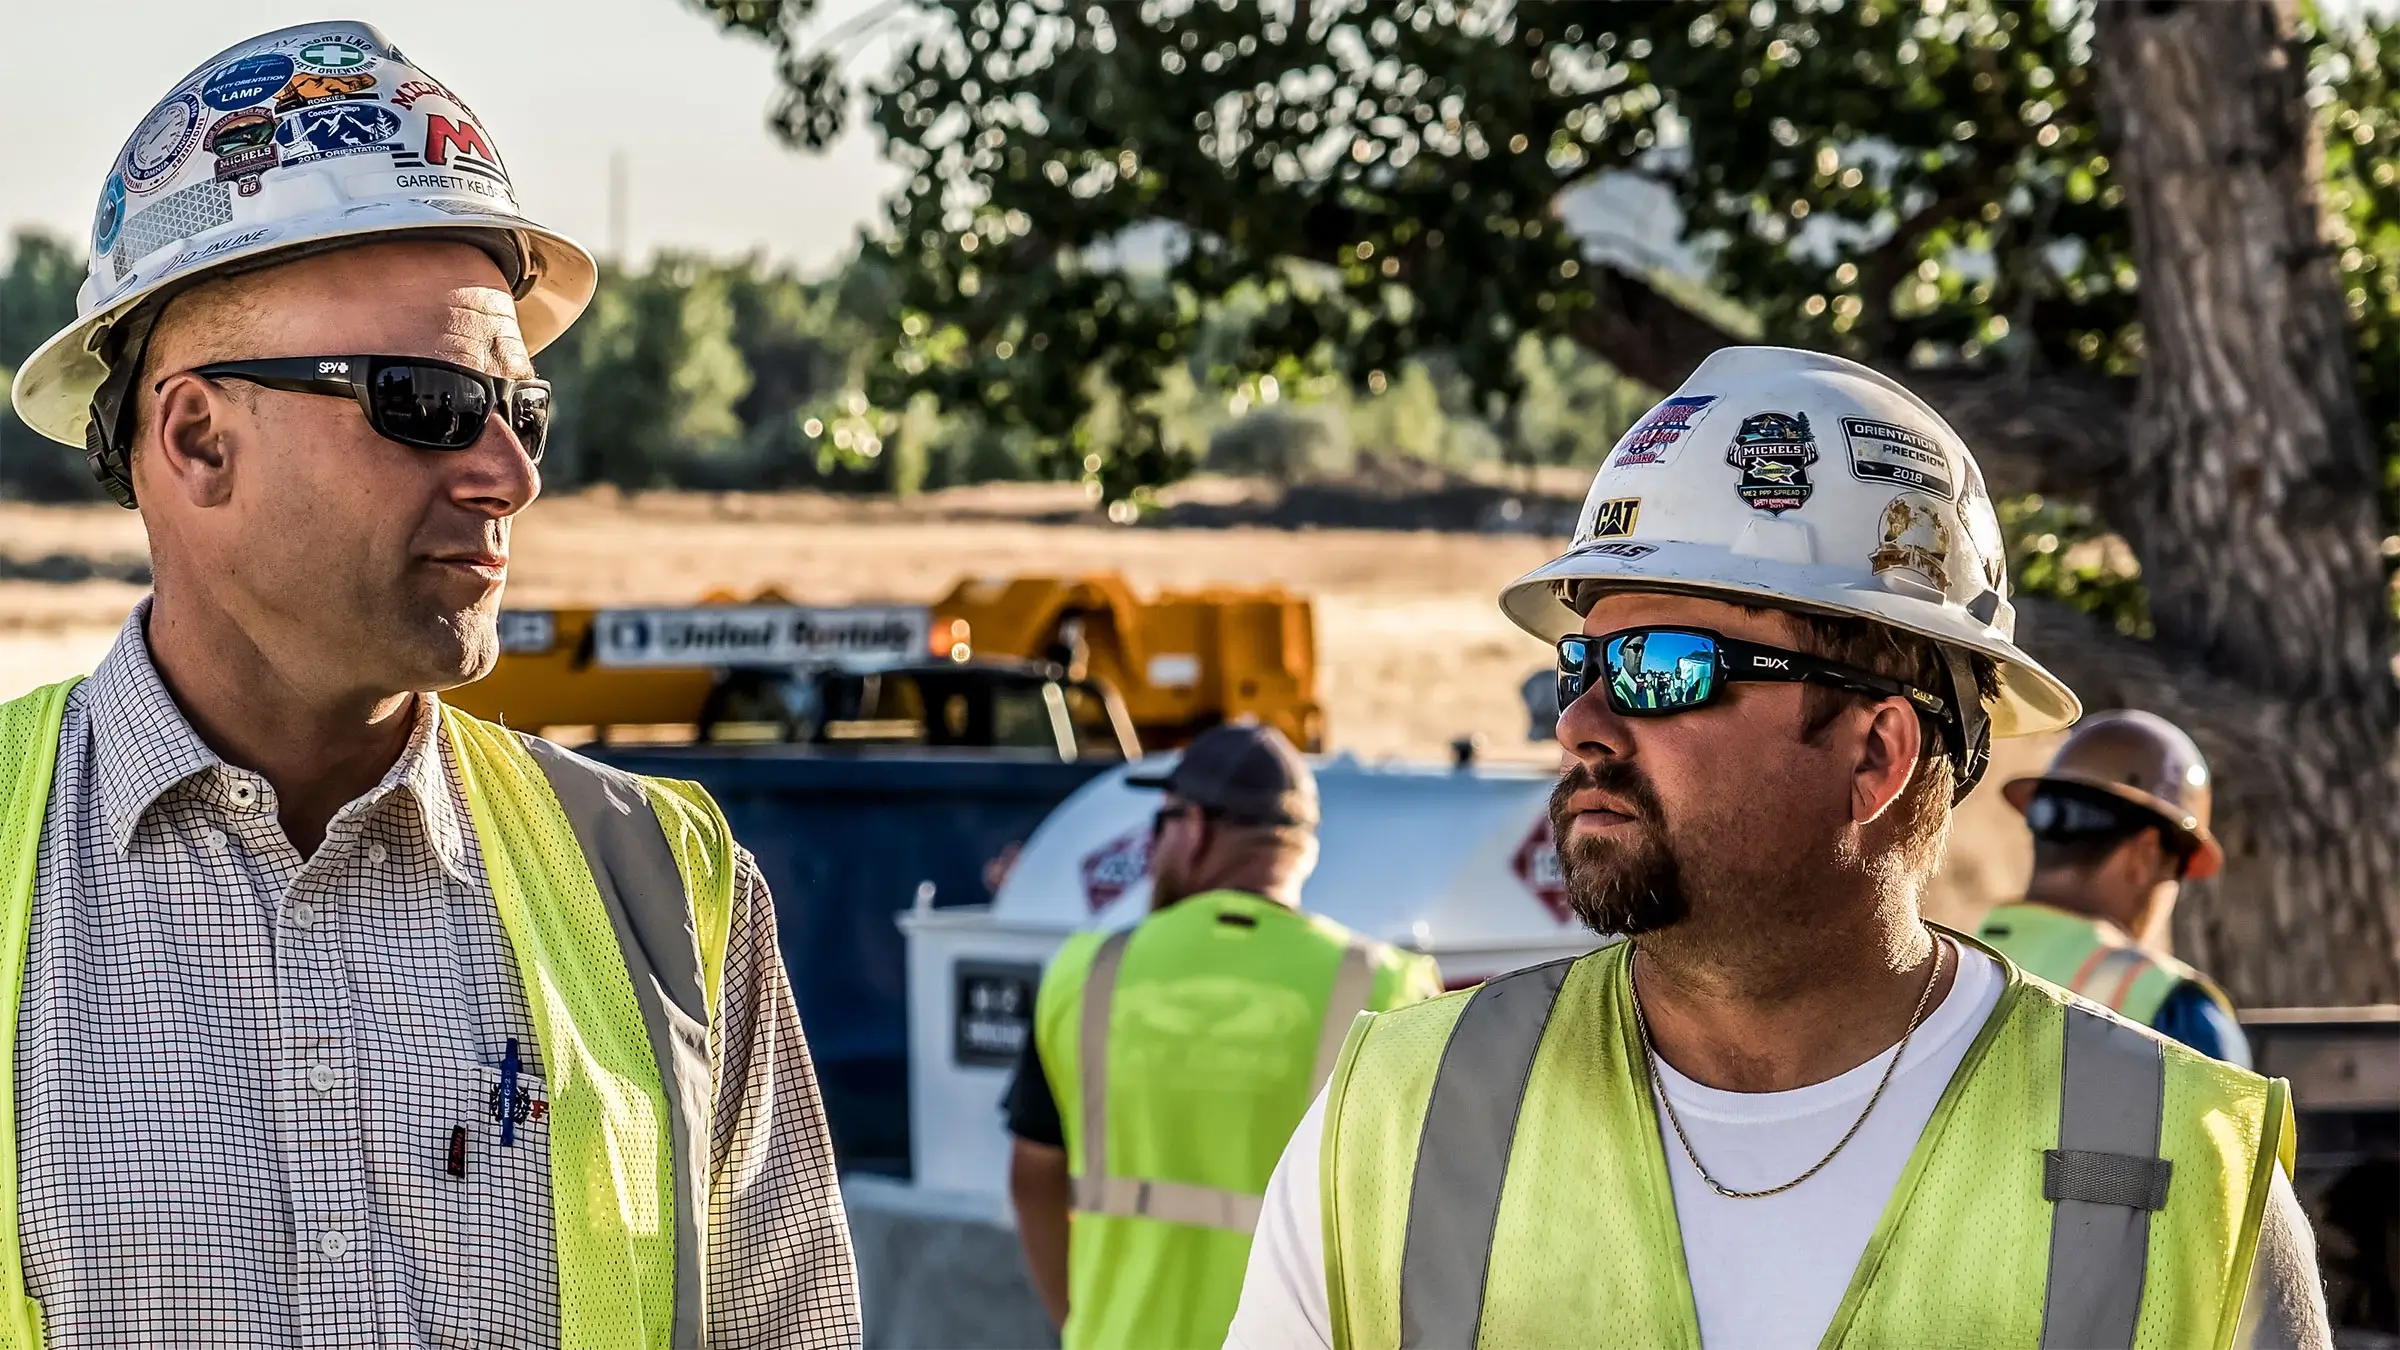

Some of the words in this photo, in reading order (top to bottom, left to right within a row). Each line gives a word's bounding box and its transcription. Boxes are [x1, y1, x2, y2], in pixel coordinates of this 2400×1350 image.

[346, 35, 373, 51] LNG
[234, 75, 286, 87] ORIENTATION
[221, 87, 263, 103] LAMP
[307, 94, 347, 106] ROCKIES
[308, 104, 361, 118] ConocoPhillips
[424, 112, 497, 166] M
[143, 160, 170, 178] OMNIA
[171, 127, 193, 156] VINCIT
[219, 147, 272, 168] MICHELS
[298, 154, 322, 164] 2015
[325, 144, 391, 158] ORIENTATION
[242, 182, 257, 194] 66
[396, 174, 464, 191] GARRETT
[318, 361, 339, 374] SPY
[1854, 423, 1938, 452] ORIENTATION
[1743, 446, 1802, 456] MICHELS
[1883, 443, 1945, 471] PRECISION
[1892, 467, 1924, 484] 2018
[1593, 500, 1639, 539] CAT
[503, 1097, 511, 1119] PILOT
